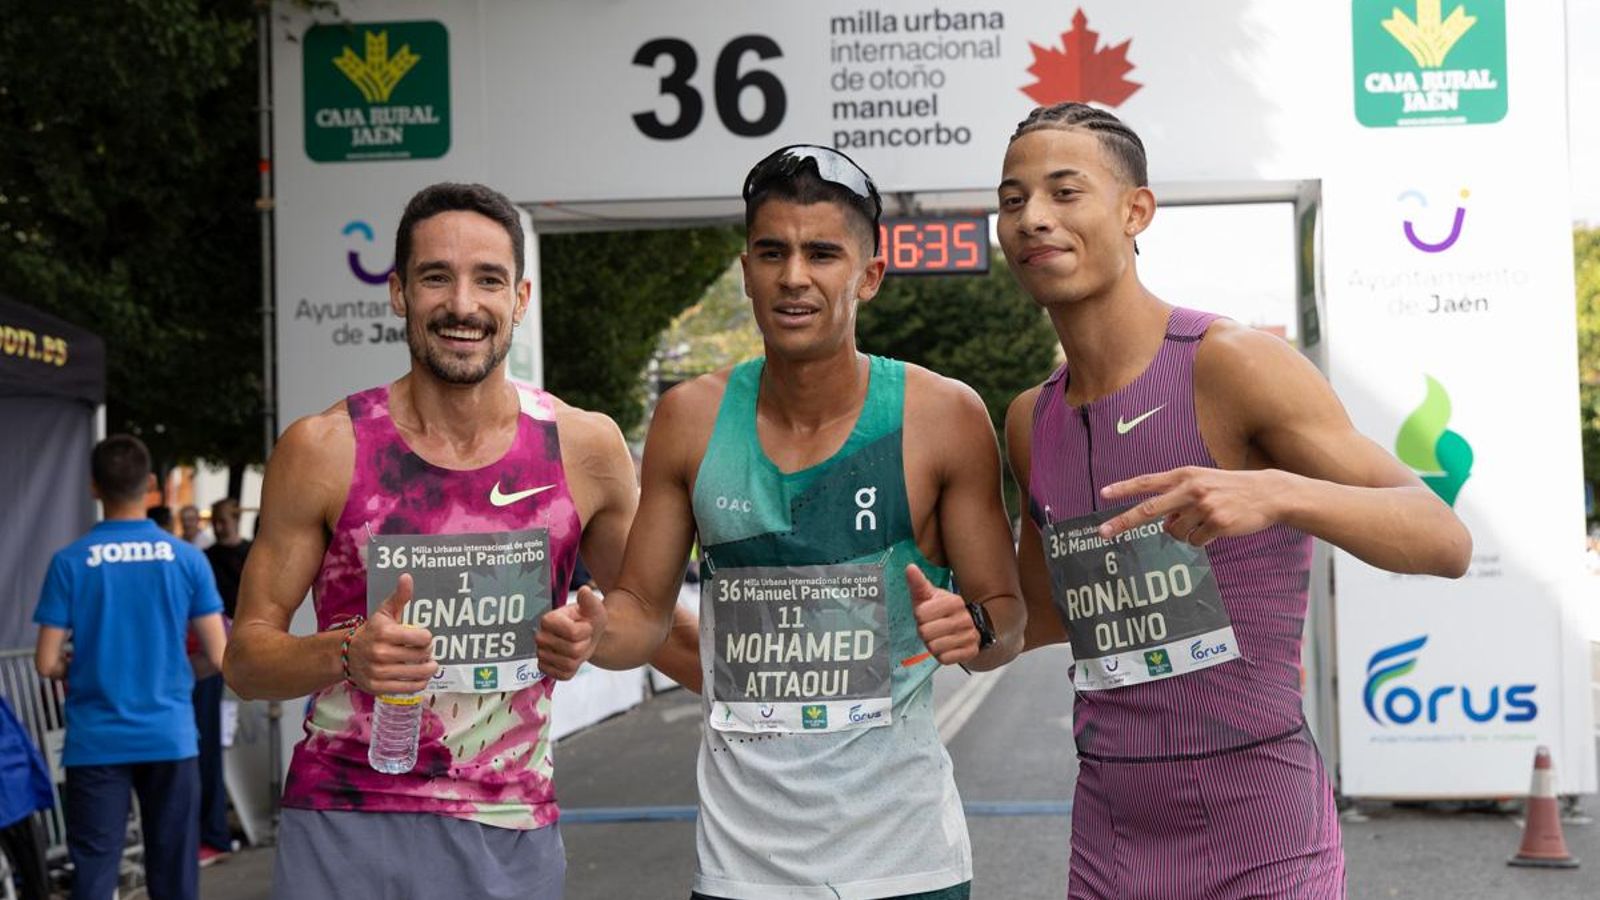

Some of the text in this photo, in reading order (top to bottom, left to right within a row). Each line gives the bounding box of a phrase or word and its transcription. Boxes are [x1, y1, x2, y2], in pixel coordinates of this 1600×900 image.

[830, 8, 1005, 35] milla urbana
[830, 36, 1002, 62] internacional
[631, 33, 788, 140] 36
[831, 65, 946, 92] de otoño
[1365, 69, 1498, 93] CAJA RURAL
[315, 105, 440, 128] CAJA RURAL
[832, 95, 938, 120] manuel
[832, 122, 972, 149] pancorbo
[294, 299, 392, 324] Ayunta
[1427, 293, 1490, 314] Jaén
[332, 323, 408, 346] de Ja
[716, 496, 752, 513] OAC
[376, 546, 408, 569] 36
[411, 546, 433, 554] Milla
[433, 545, 462, 554] Urbana
[411, 548, 545, 569] Manuel Pancorbo
[1105, 551, 1119, 575] 6
[457, 571, 472, 594] 1
[718, 579, 741, 602] 36
[841, 575, 852, 584] de
[743, 583, 878, 602] Manuel Pancorbo
[1065, 563, 1193, 621] RONALDO
[402, 594, 526, 629] IGNACIO
[777, 606, 805, 629] 11
[1094, 612, 1168, 651] OLIVO
[430, 632, 517, 661] ONTES
[726, 629, 875, 664] MOHAMED
[1190, 640, 1228, 660] Forus
[743, 669, 850, 698] ATTAOUI
[1363, 634, 1538, 728] Forus
[848, 704, 883, 722] Forus
